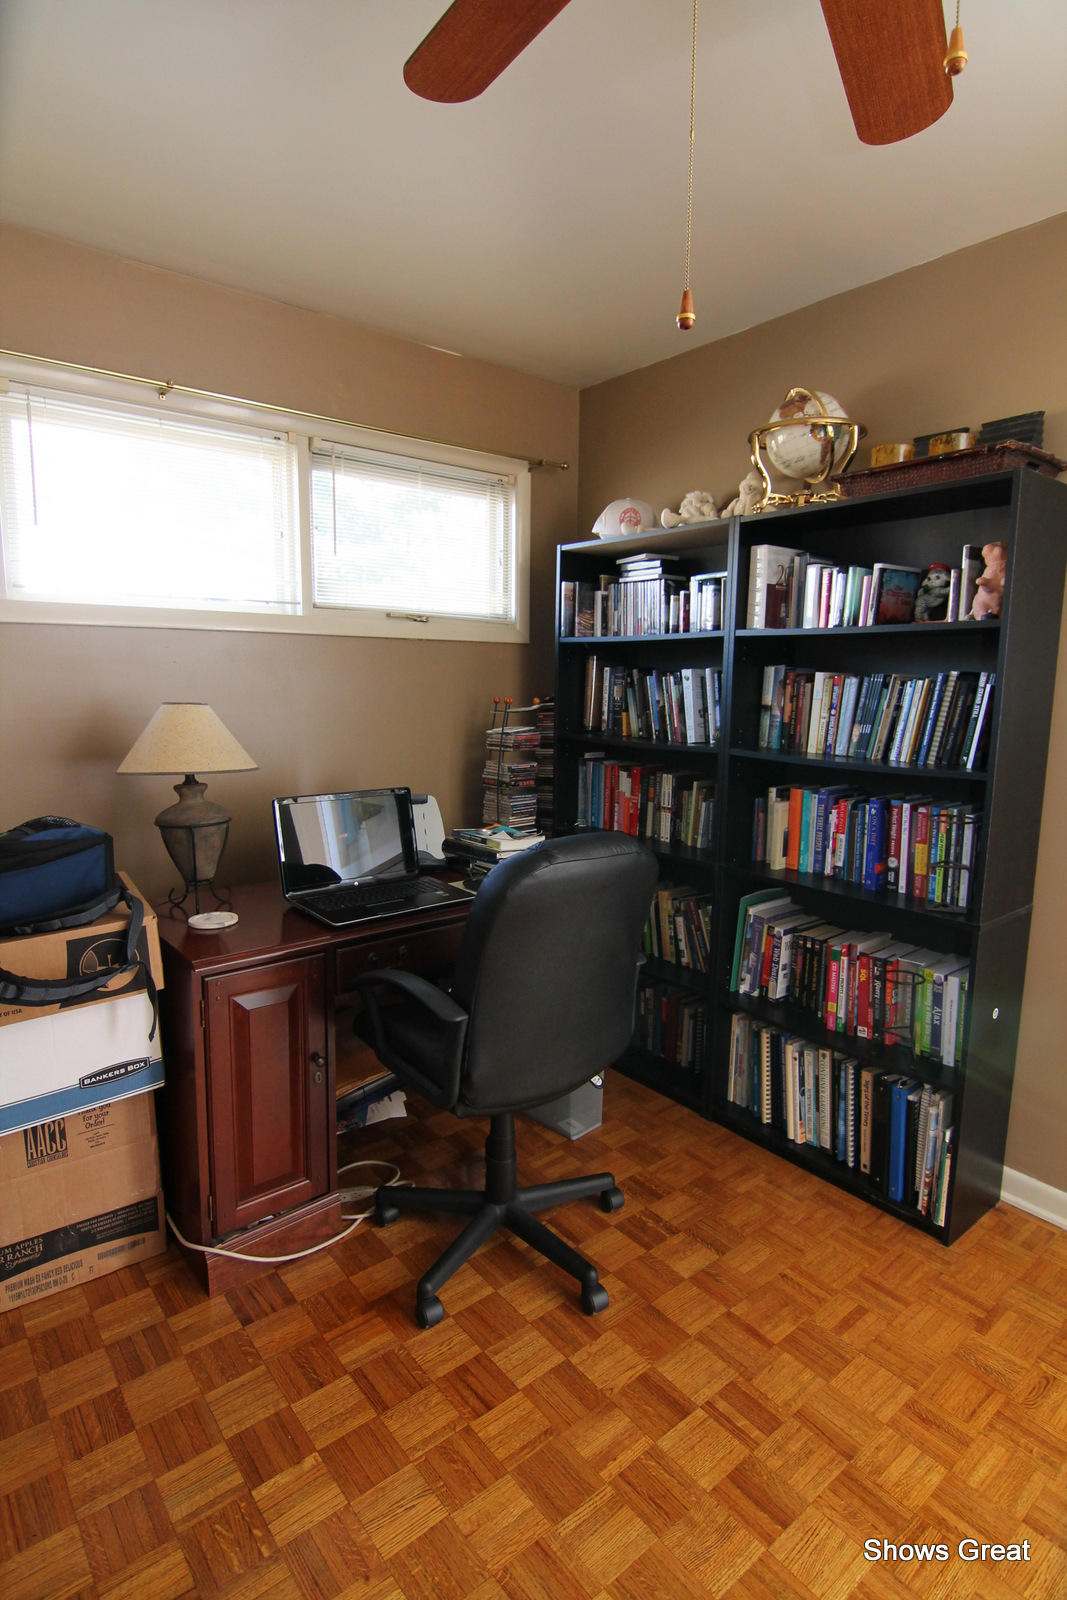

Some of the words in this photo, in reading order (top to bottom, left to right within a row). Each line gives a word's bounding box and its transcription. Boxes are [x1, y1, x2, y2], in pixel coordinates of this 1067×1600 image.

[932, 1006, 943, 1026] Ajax
[84, 1067, 126, 1085] BANKERS
[127, 1061, 146, 1072] BOX
[819, 1060, 827, 1093] CONTAINER
[82, 1114, 93, 1122] for
[94, 1111, 109, 1121] your
[819, 1094, 827, 1130] GARDENING
[85, 1117, 105, 1129] Order!
[26, 1117, 67, 1160] AACC
[7, 1244, 43, 1261] RANCH
[15, 1238, 43, 1251] APPLES
